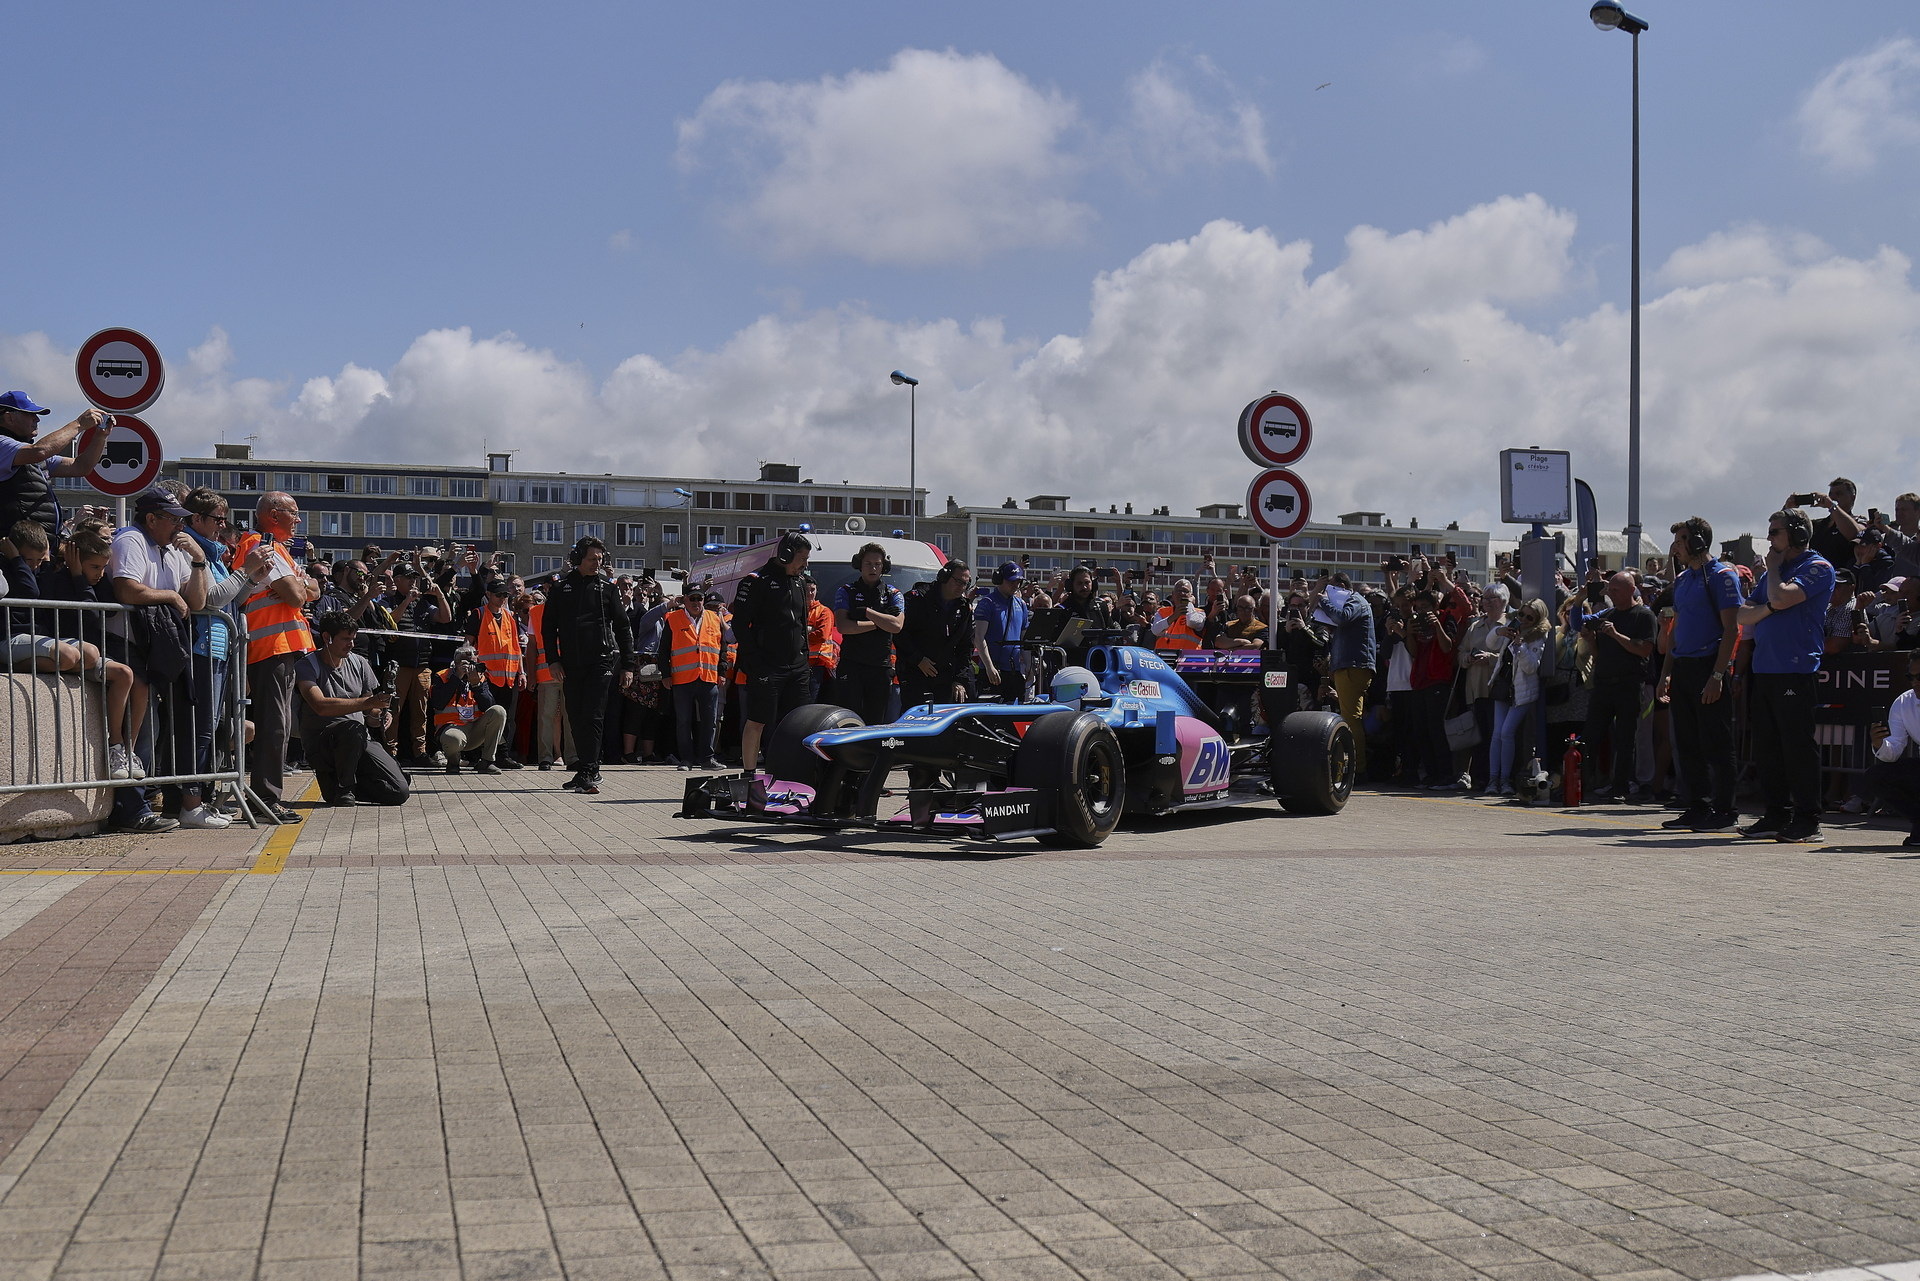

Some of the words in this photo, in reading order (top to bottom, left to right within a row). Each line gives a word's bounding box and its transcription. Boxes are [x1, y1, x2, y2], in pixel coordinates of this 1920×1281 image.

[1530, 454, 1548, 463] Plage
[1137, 682, 1160, 697] Castrol
[985, 803, 1031, 818] MANDANT
